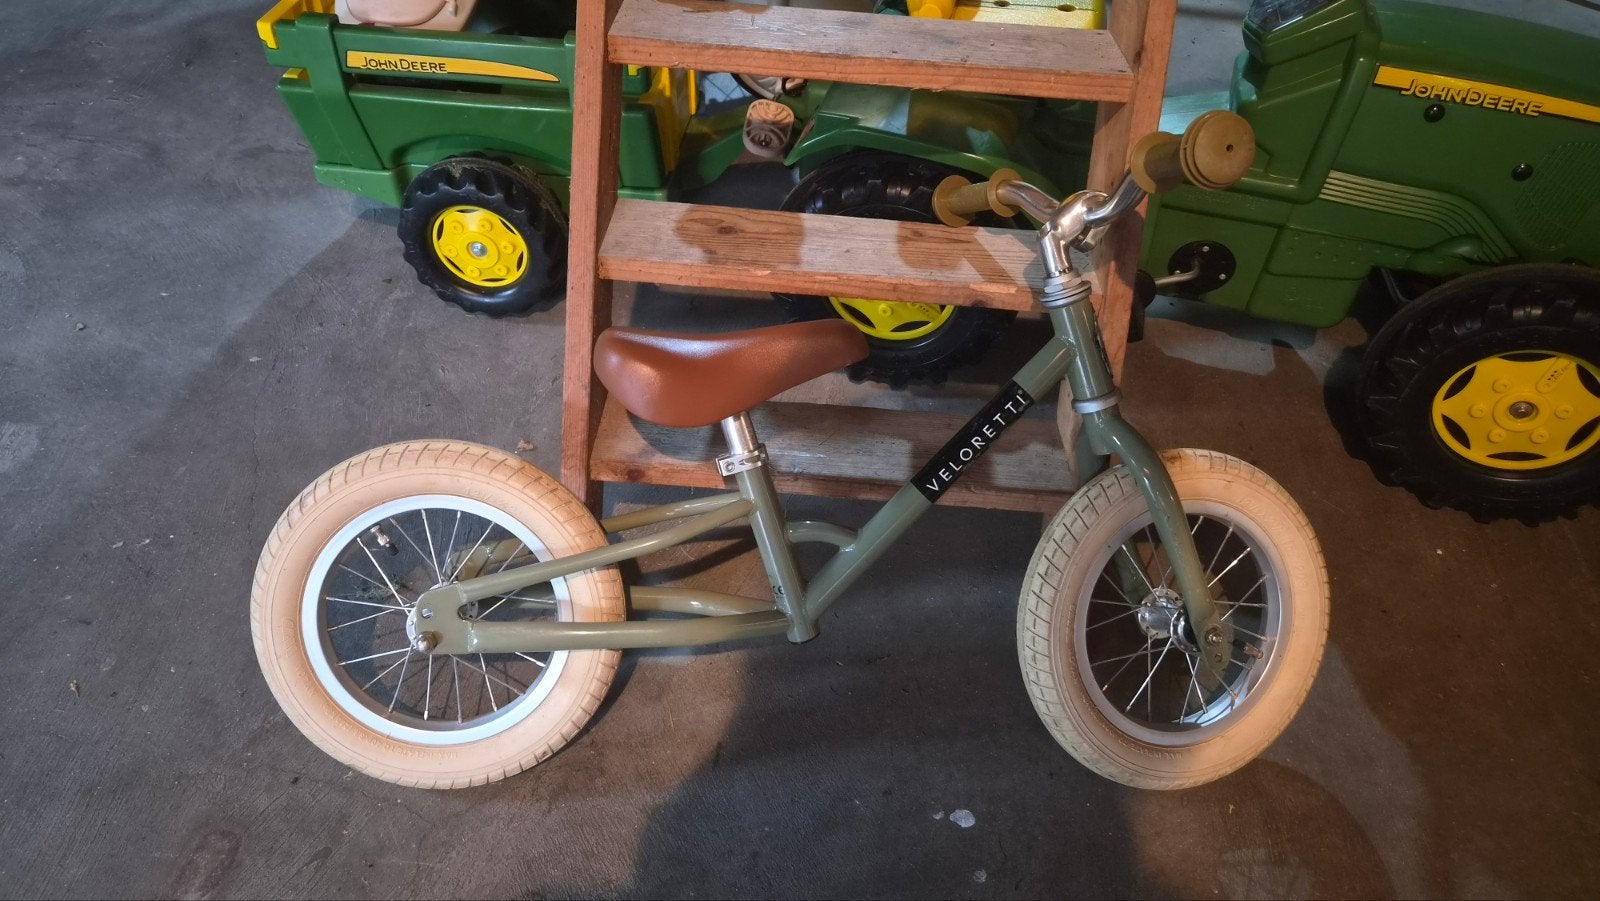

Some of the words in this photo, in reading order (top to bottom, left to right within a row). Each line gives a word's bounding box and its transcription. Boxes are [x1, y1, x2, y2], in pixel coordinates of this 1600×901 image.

[361, 56, 398, 69] JOHN
[399, 58, 447, 72] DEERE
[1401, 79, 1464, 103] JOHN
[1465, 87, 1544, 116] DEERE
[926, 394, 1026, 491] VELORETTI
